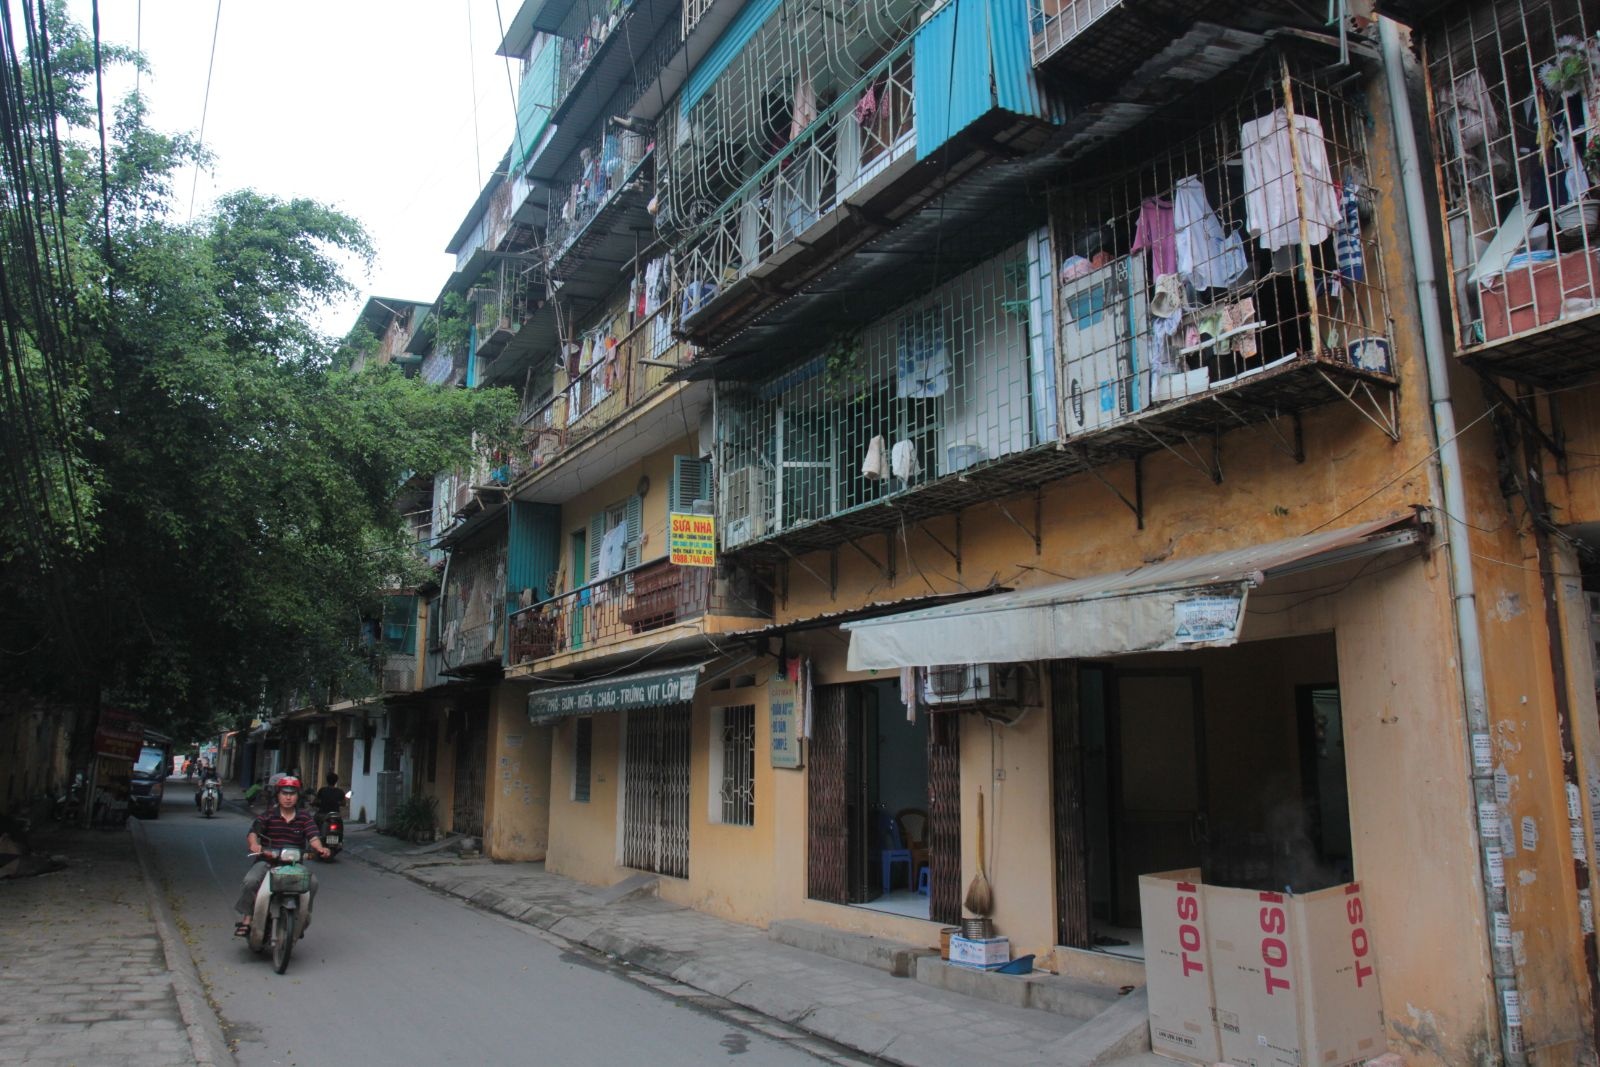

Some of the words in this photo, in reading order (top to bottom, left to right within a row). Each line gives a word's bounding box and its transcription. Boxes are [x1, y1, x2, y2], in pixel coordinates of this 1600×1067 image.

[1118, 259, 1128, 282] 32
[673, 516, 690, 532] SỬA
[694, 520, 712, 533] NHÀ
